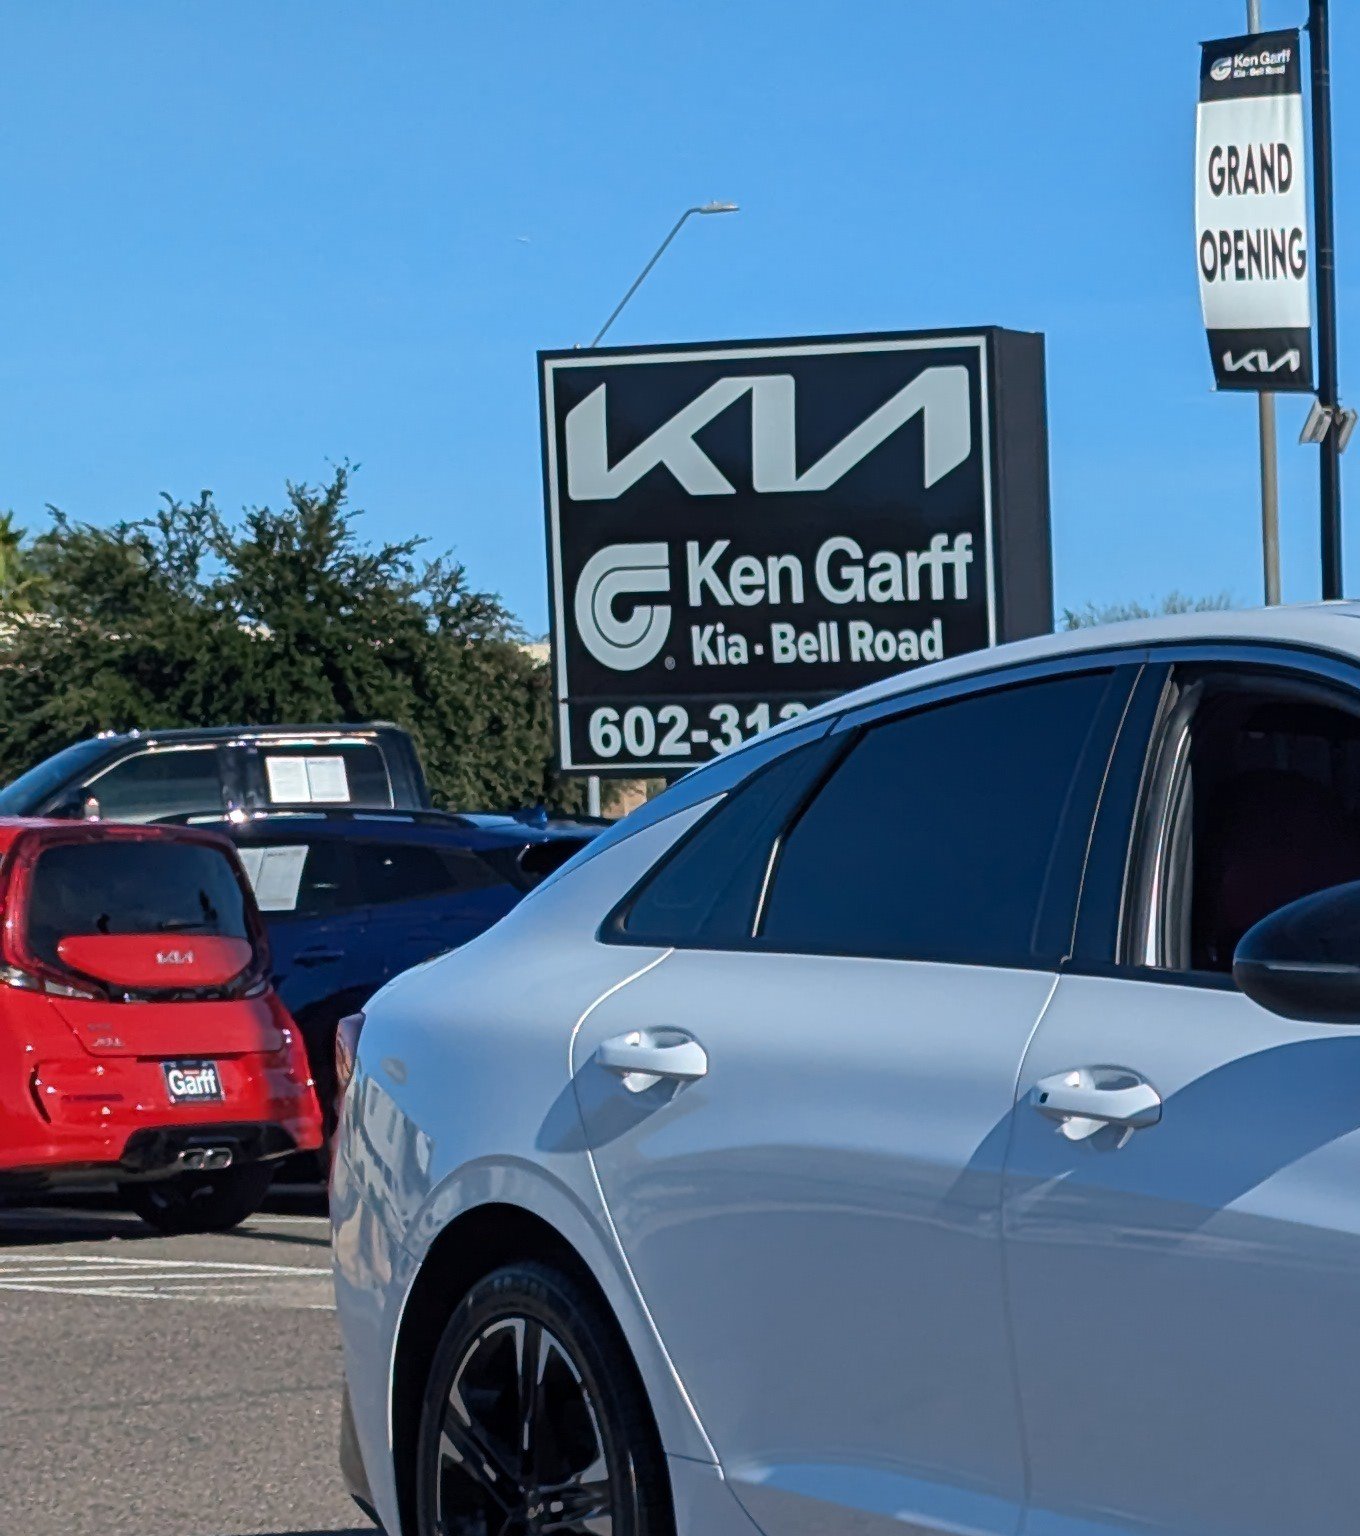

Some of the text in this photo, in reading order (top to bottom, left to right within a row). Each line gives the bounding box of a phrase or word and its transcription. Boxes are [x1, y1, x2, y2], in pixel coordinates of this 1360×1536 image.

[1208, 143, 1292, 197] GRAND
[1200, 228, 1306, 283] OPENING
[1222, 349, 1300, 373] KIA
[565, 365, 971, 500] KIA
[686, 532, 973, 607] Ken Garff
[691, 618, 944, 666] Kia Bell Road
[168, 1068, 217, 1096] Garff
